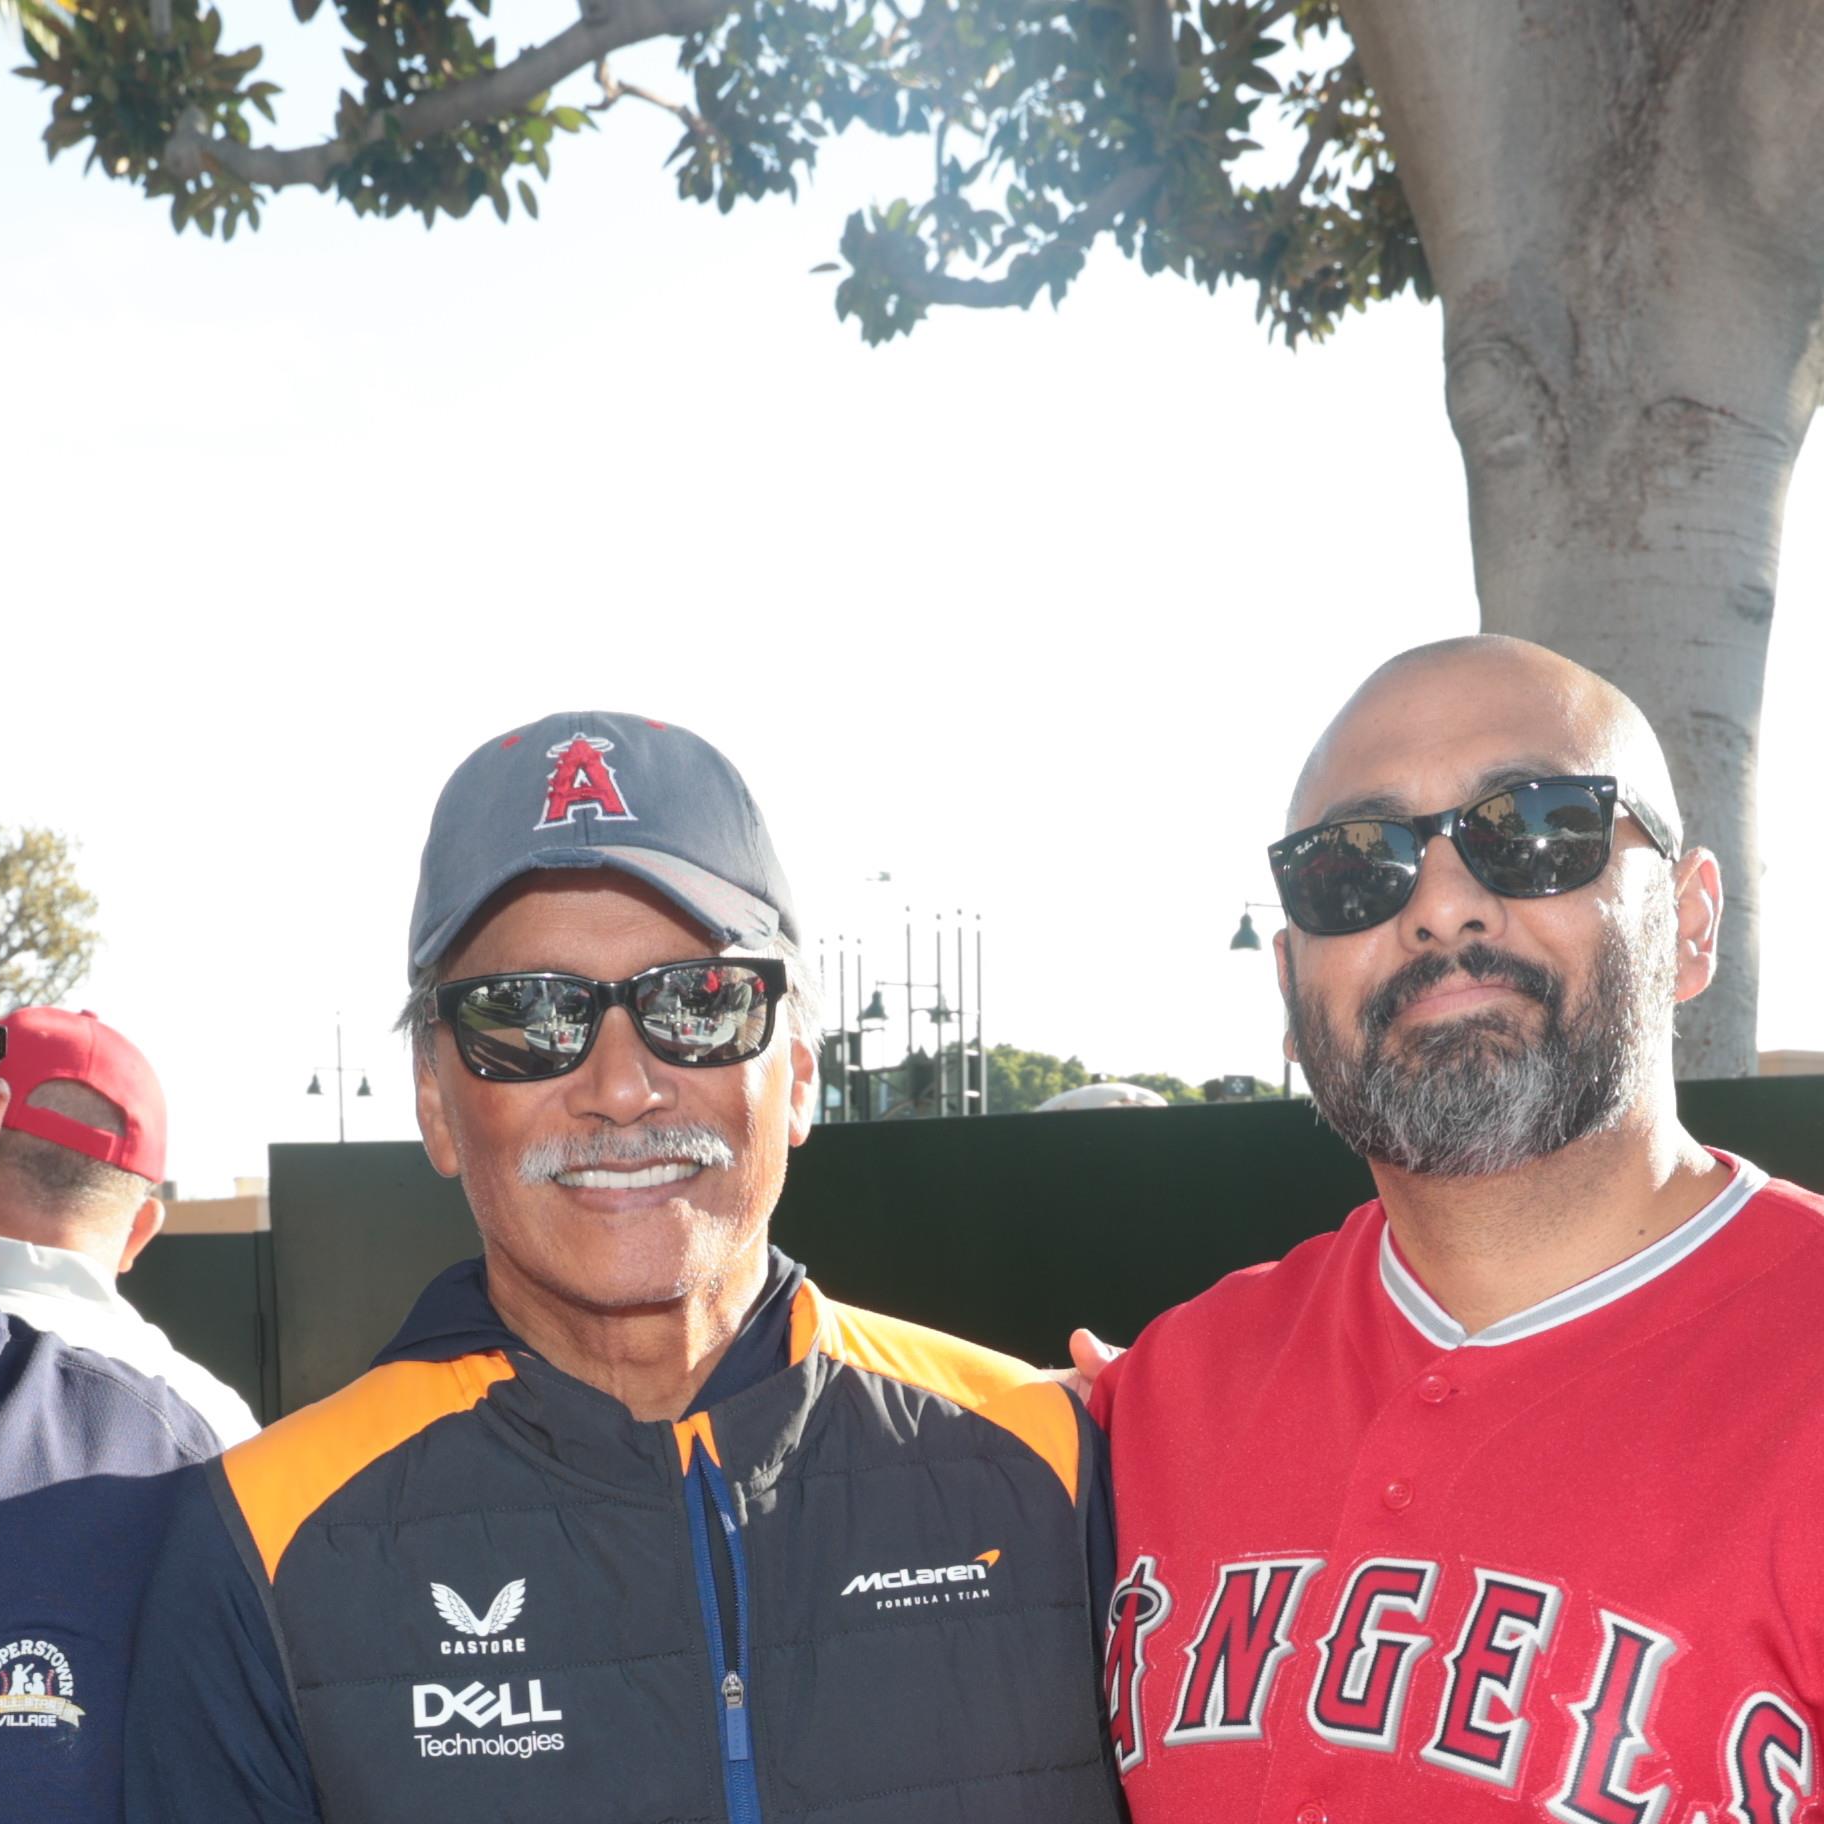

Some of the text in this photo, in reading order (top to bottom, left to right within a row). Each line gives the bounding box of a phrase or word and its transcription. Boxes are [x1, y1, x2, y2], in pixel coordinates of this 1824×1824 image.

[533, 732, 638, 831] A
[840, 1564, 987, 1596] McLaren
[877, 1588, 991, 1610] FORMULA 1 TEAM
[440, 1638, 526, 1655] CASTORE
[412, 1679, 563, 1728] DELL
[413, 1731, 565, 1759] Technologies
